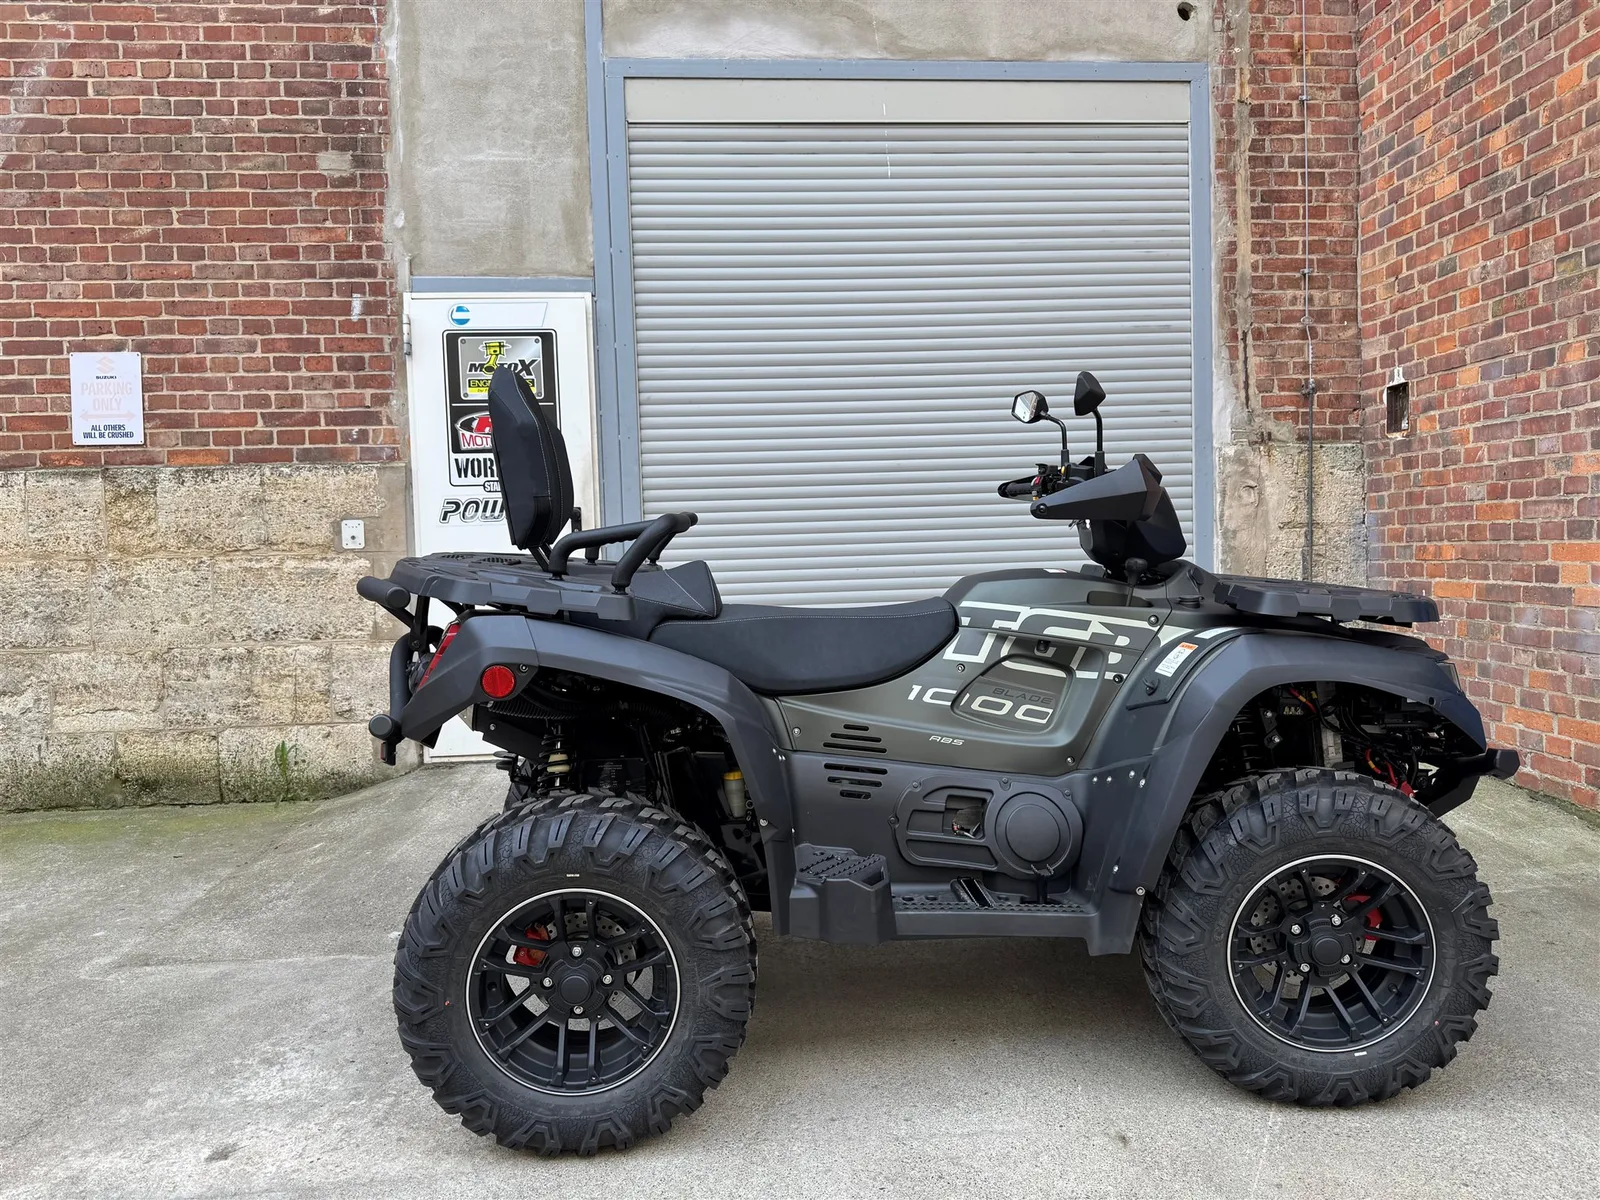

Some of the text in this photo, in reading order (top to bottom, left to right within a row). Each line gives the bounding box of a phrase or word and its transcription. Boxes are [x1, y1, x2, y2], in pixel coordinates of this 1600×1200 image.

[81, 381, 132, 397] PARKING
[93, 397, 122, 412] ONLY
[83, 431, 134, 439] WILL BE CRUSHED
[91, 424, 126, 432] ALL OTHERS
[454, 457, 499, 479] WOR
[993, 687, 1055, 704] BLADE
[907, 684, 1054, 724] 1000
[929, 735, 965, 746] ABS
